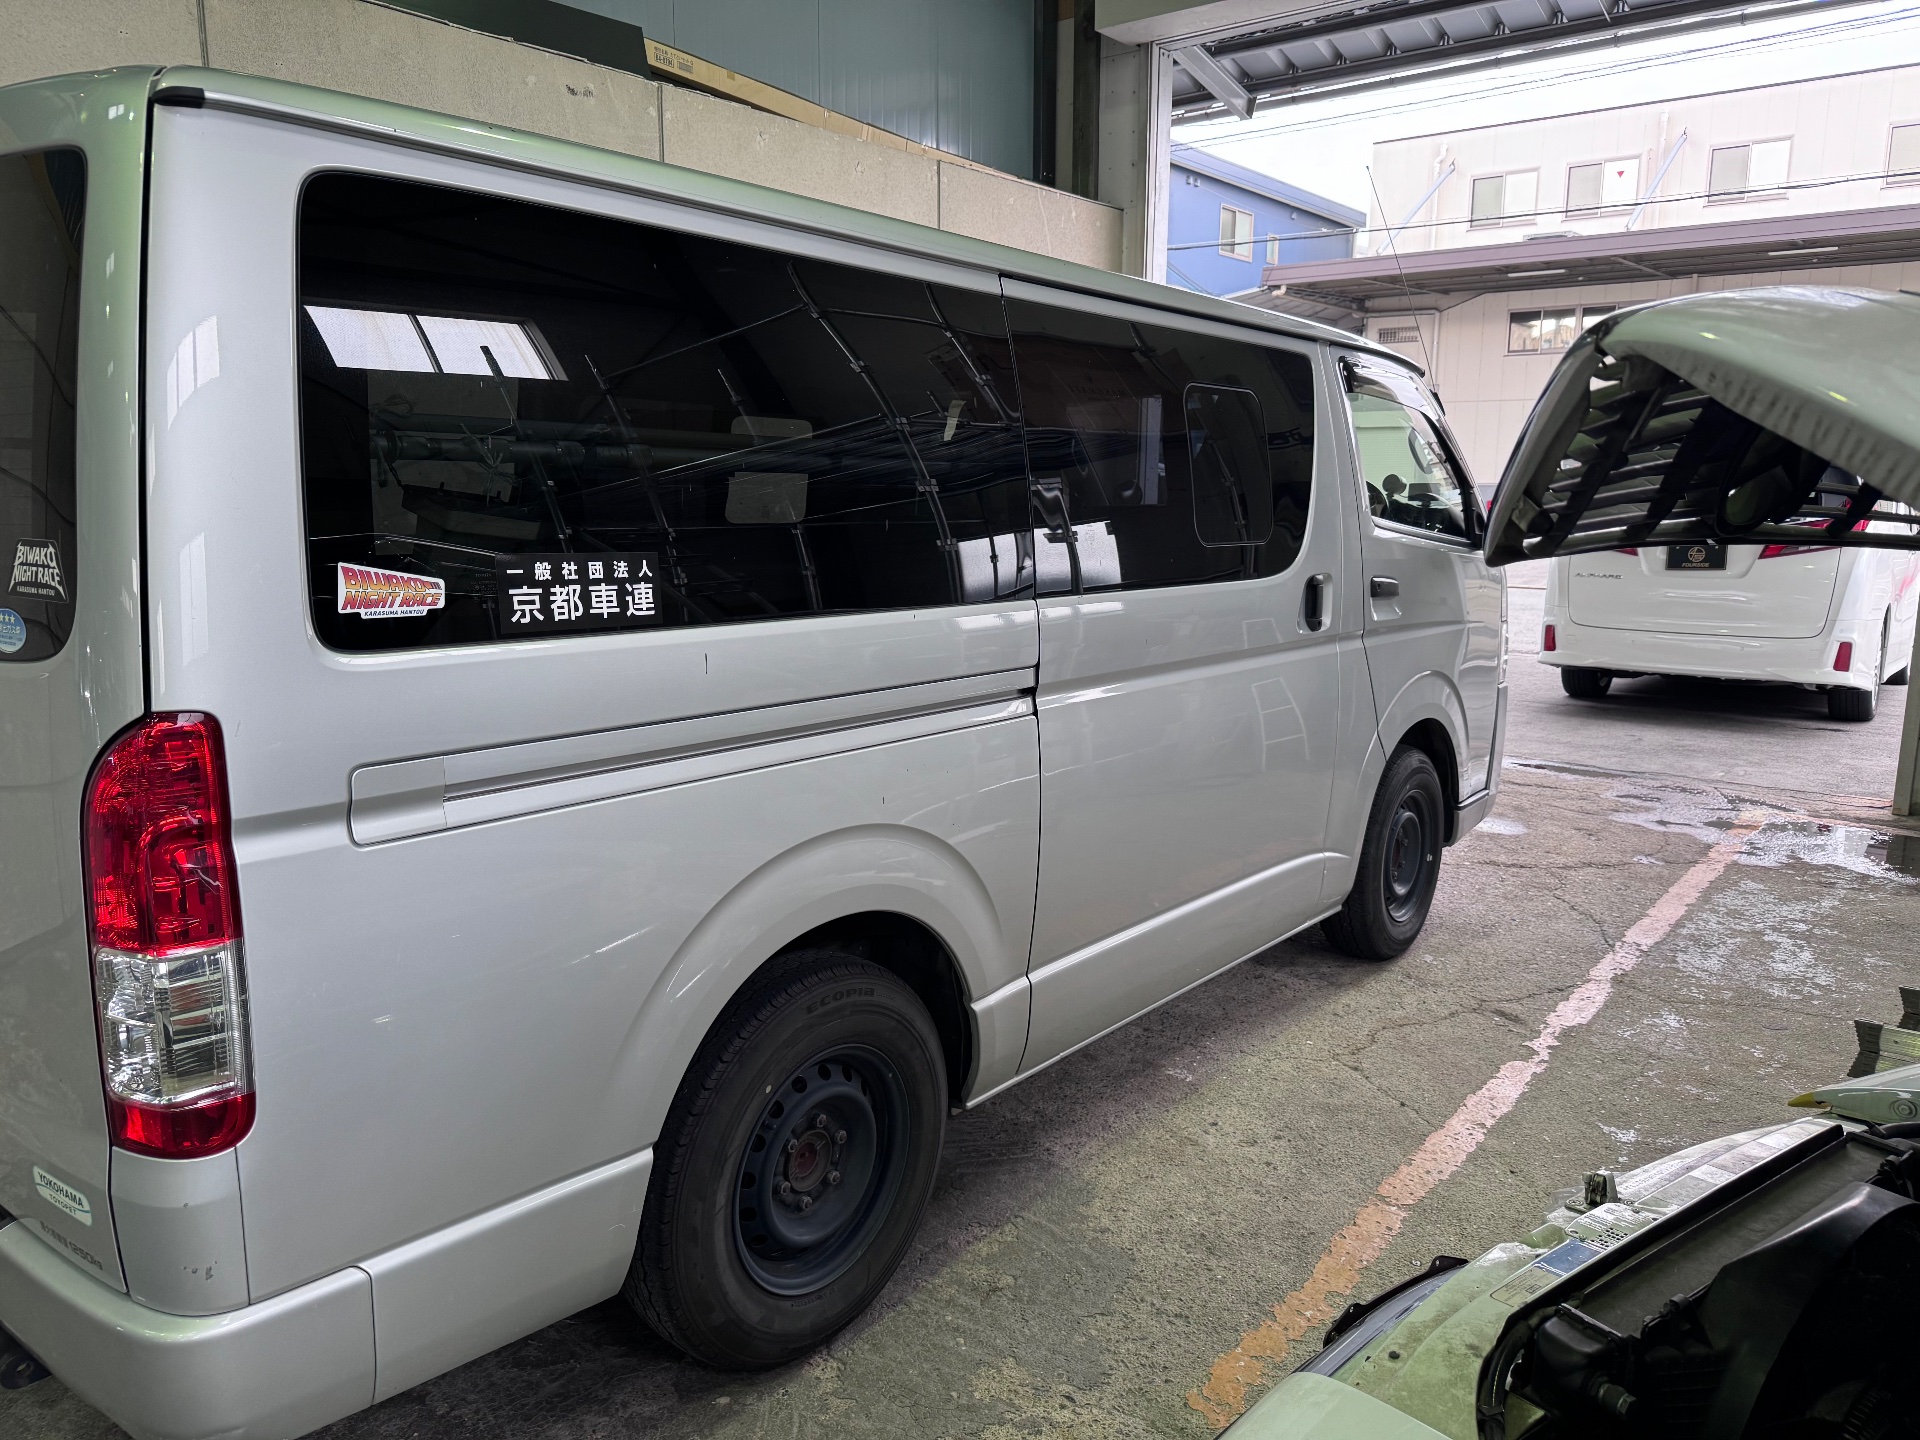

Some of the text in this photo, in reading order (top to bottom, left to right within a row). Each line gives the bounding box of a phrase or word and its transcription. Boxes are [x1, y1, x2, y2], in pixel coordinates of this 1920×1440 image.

[13, 541, 58, 570] BIWAKO
[8, 564, 66, 599] NIGHT RACE
[340, 566, 427, 593] BIWAKO
[506, 560, 653, 580] 一般社団法人
[16, 585, 38, 594] KARASUMA
[341, 591, 443, 611] NIGHT RACE
[364, 608, 425, 617] KARASUMA HANTOU
[508, 582, 655, 624] 京都車連
[38, 1171, 84, 1209] YOKOHAMA
[49, 1193, 77, 1216] TOYOPET
